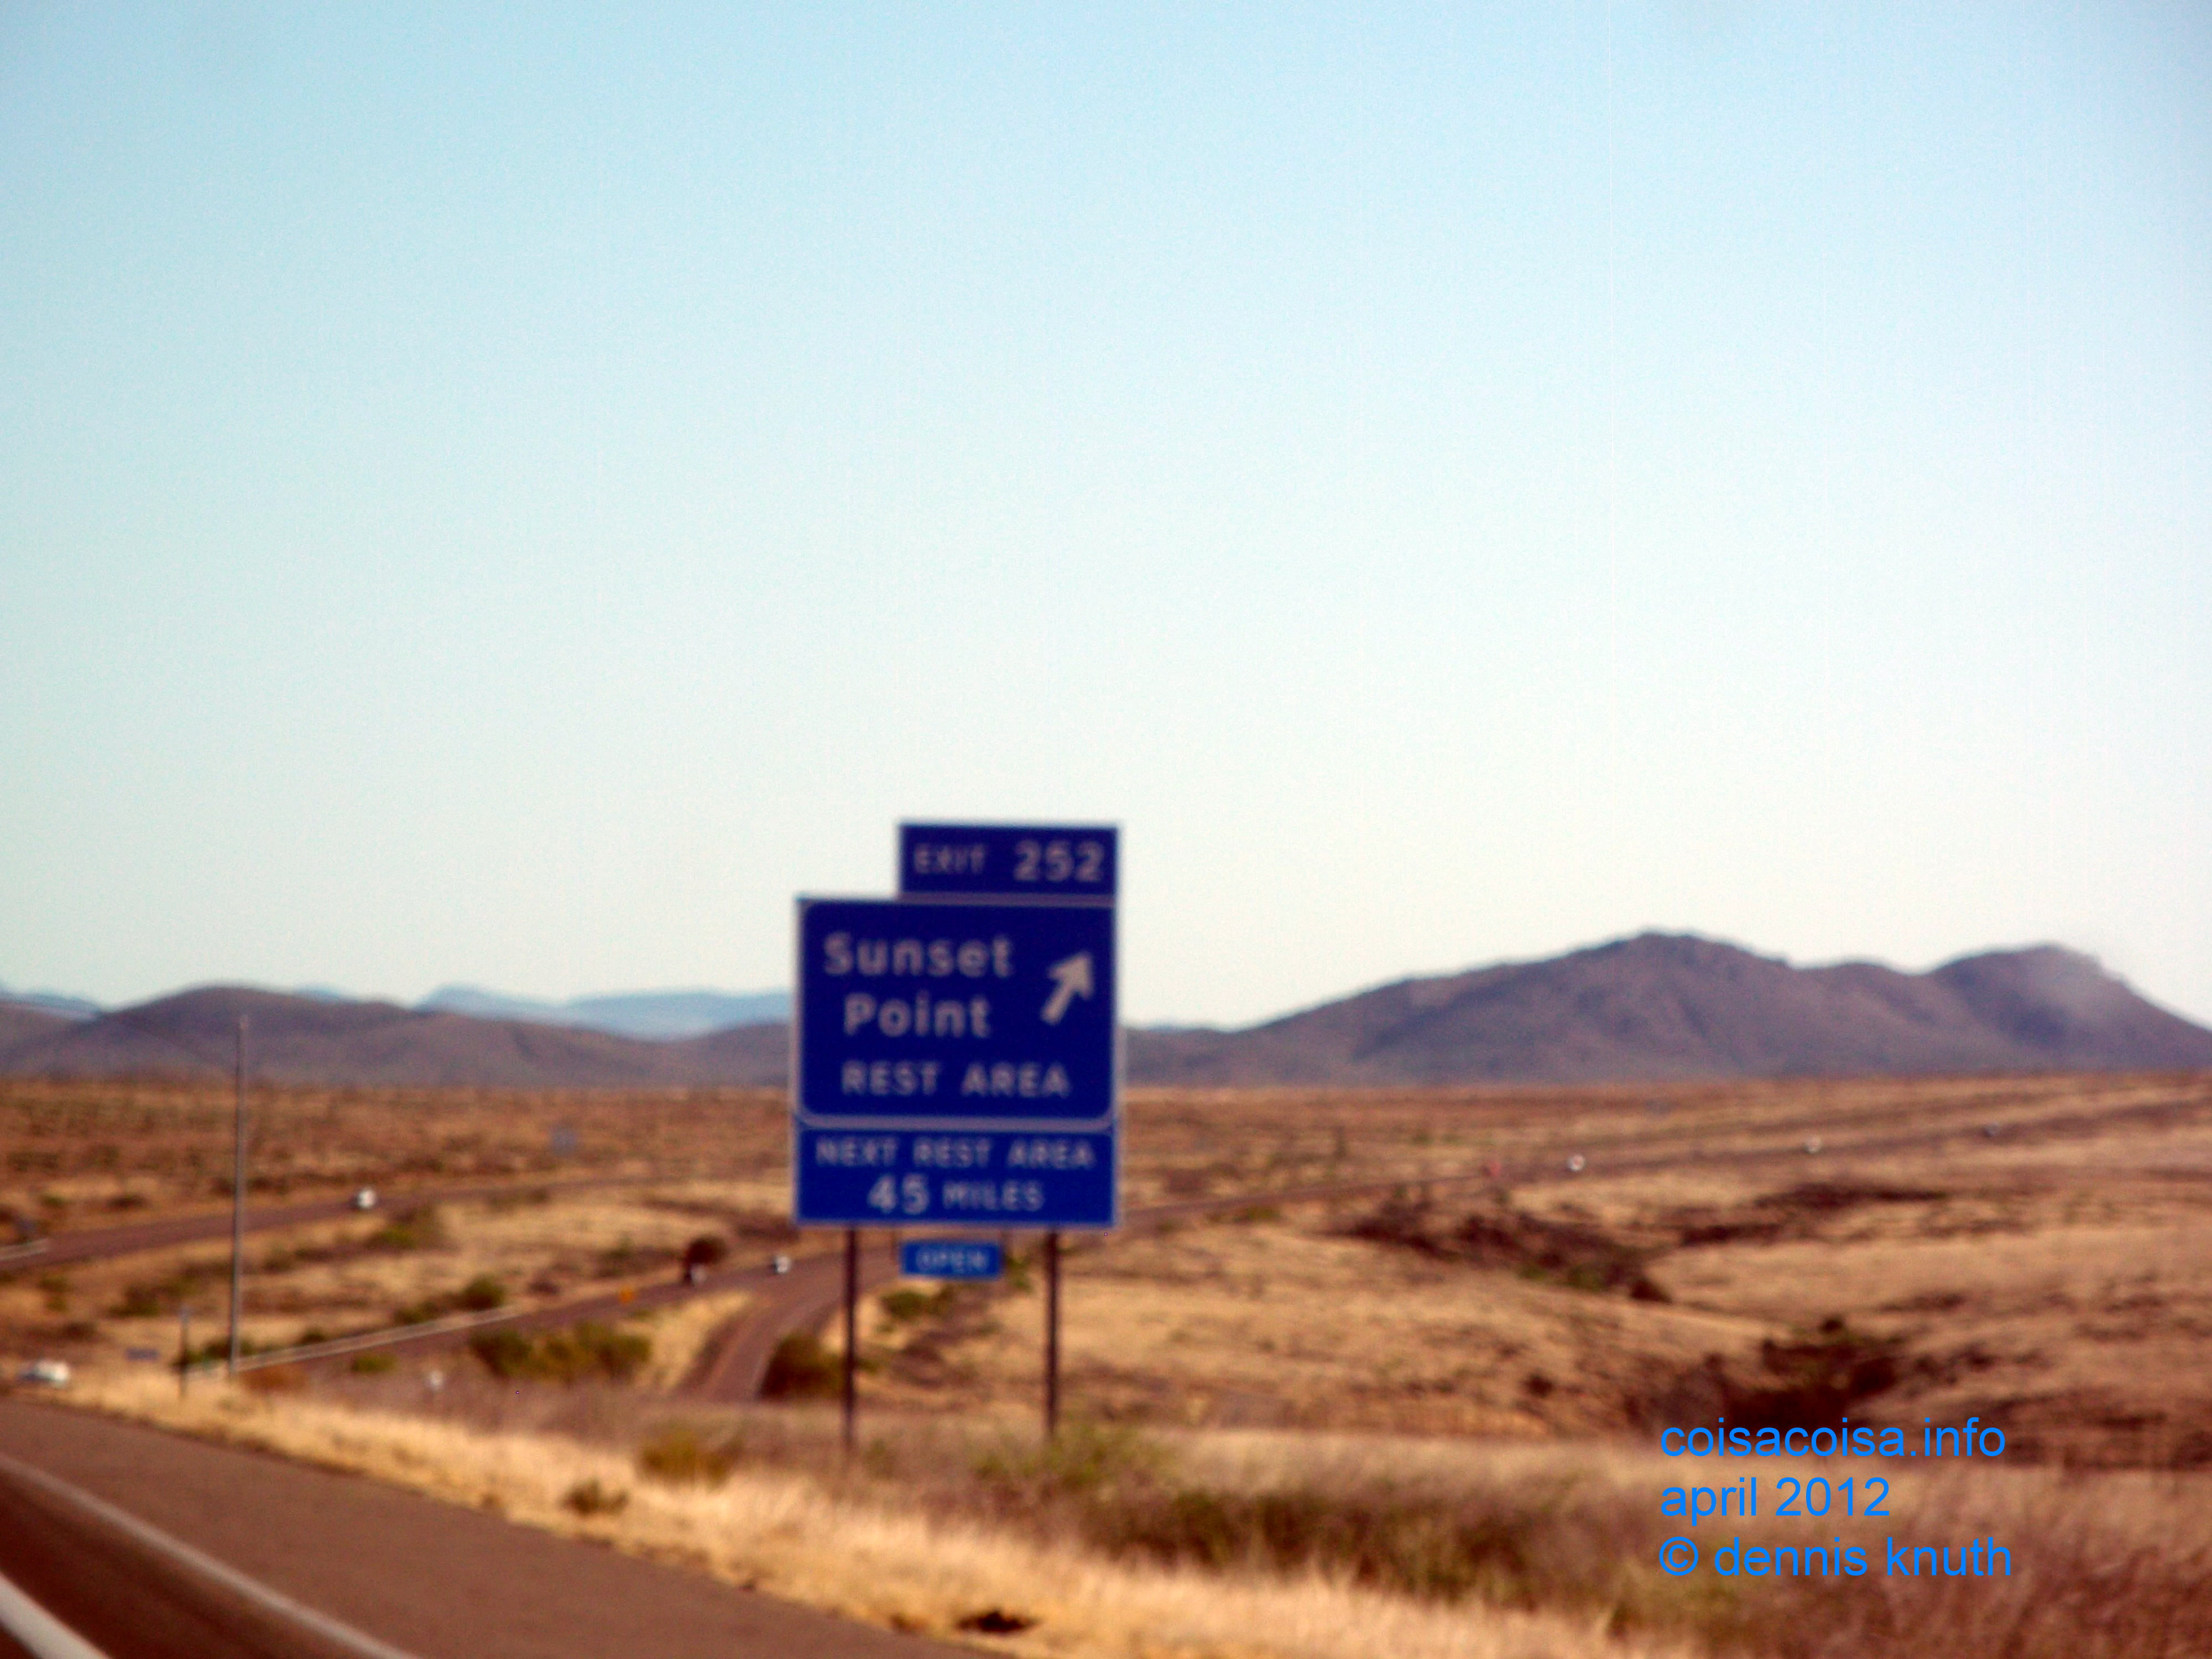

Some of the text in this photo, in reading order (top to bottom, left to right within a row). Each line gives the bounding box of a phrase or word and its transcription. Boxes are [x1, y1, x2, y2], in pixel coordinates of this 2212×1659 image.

[914, 839, 1105, 882] EXIT 252
[824, 931, 1013, 978] Sunset
[843, 990, 992, 1037] Point
[841, 1060, 1071, 1098] REST AREA
[815, 1135, 1095, 1170] NEXT REST AREA
[867, 1173, 1045, 1214] 45 MILES
[916, 1247, 989, 1271] OPEN
